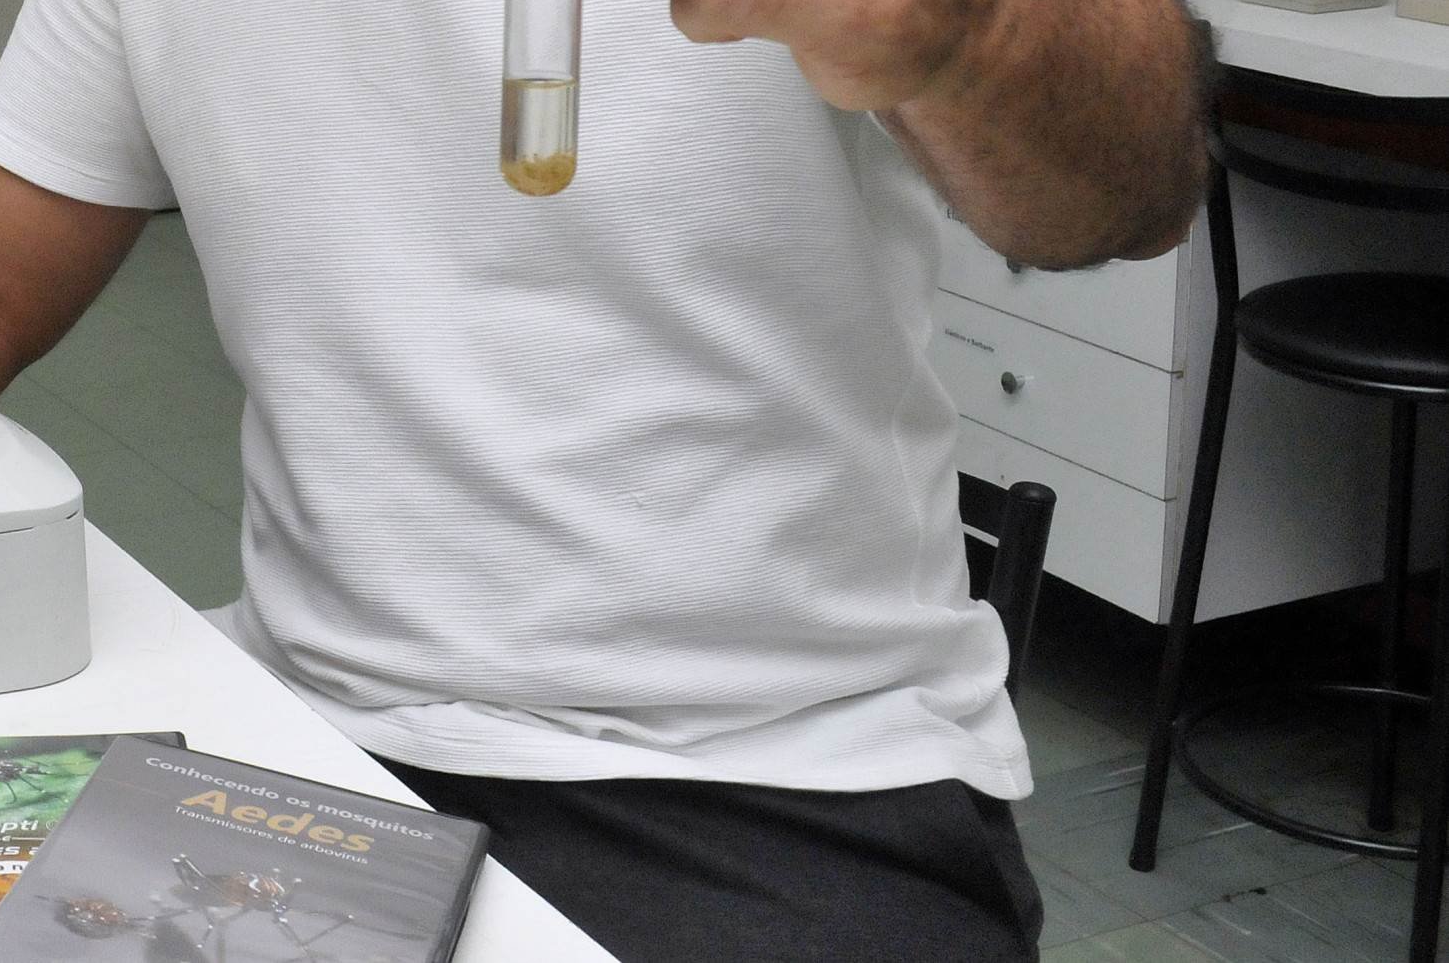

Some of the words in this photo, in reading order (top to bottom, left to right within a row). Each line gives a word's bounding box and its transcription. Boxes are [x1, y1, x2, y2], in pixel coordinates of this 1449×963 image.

[145, 756, 279, 801] Conhecendo
[285, 795, 310, 809] os
[318, 802, 434, 841] mosquitos
[175, 805, 274, 840] Transmissores
[277, 833, 296, 846] de
[180, 789, 375, 853] Aedes
